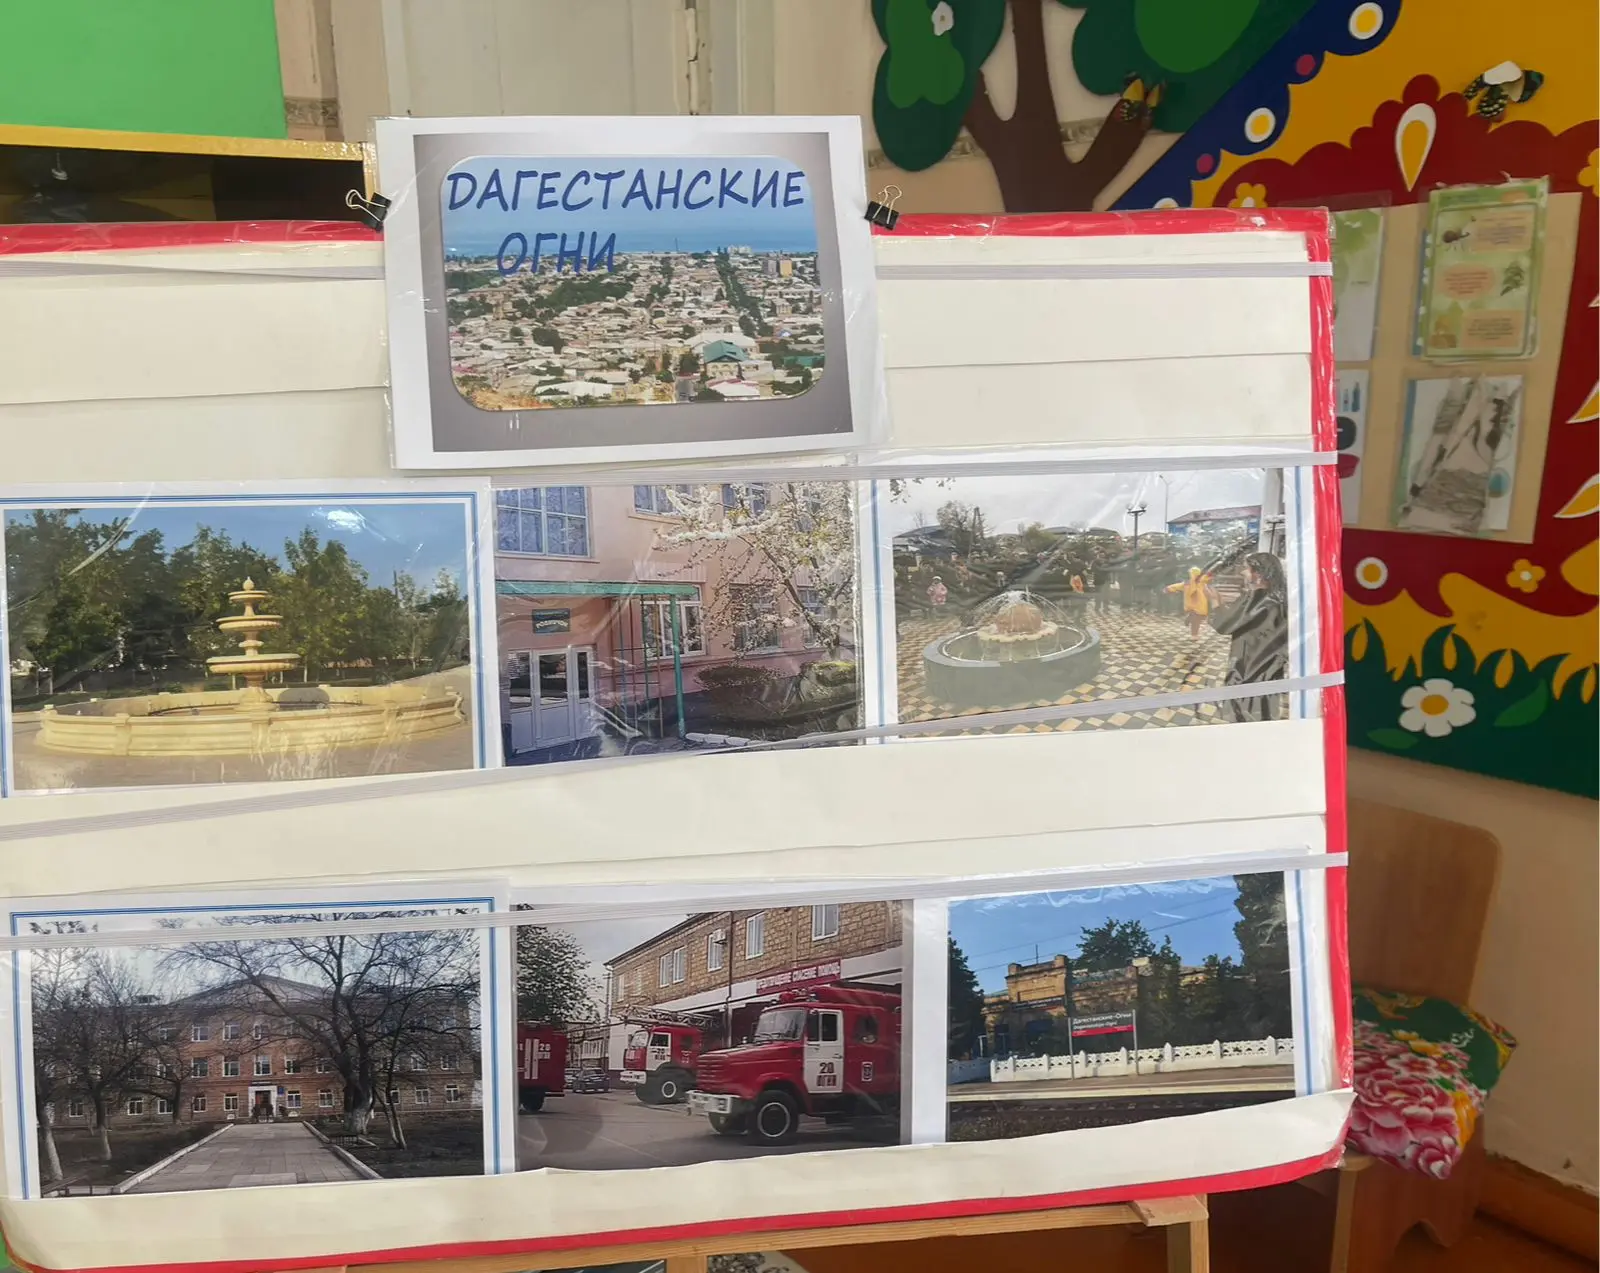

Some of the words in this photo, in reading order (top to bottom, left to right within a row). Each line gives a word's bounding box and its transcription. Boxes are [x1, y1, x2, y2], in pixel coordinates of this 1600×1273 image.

[447, 168, 806, 210] ДАГЕСТАНСКИЕ
[497, 231, 617, 275] ОГНИ
[819, 1061, 835, 1074] 20
